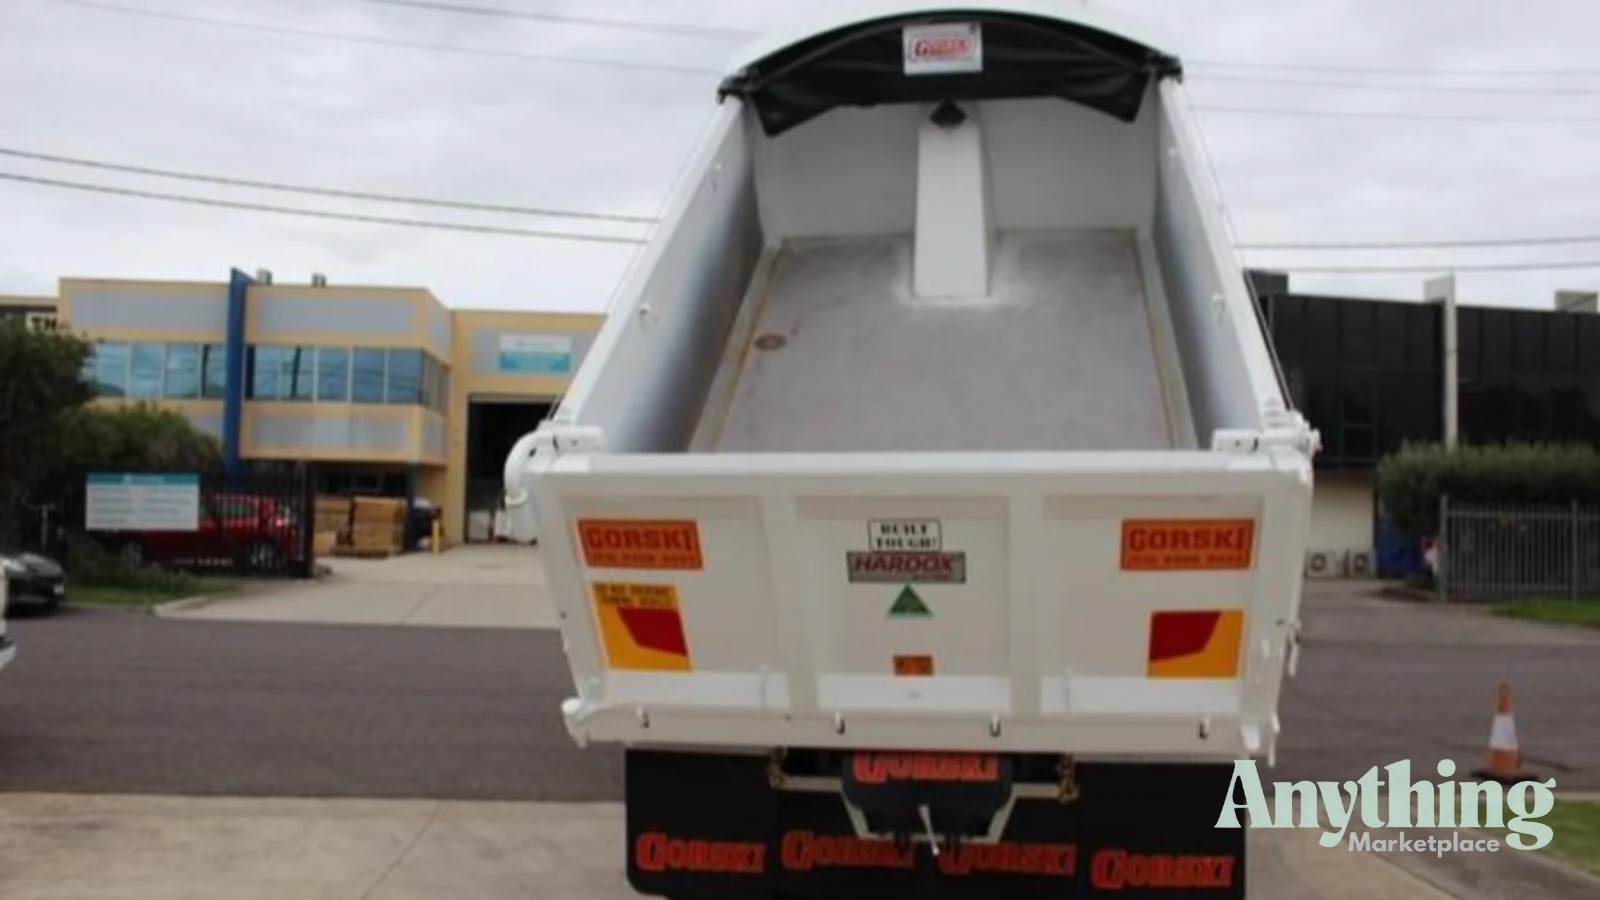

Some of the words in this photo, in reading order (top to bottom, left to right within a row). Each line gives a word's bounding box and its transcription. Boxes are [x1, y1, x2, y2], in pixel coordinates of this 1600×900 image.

[586, 527, 694, 552] GORSKI
[880, 523, 928, 535] BUILT
[1128, 527, 1246, 552] GORSKI
[854, 554, 953, 573] HARDOX
